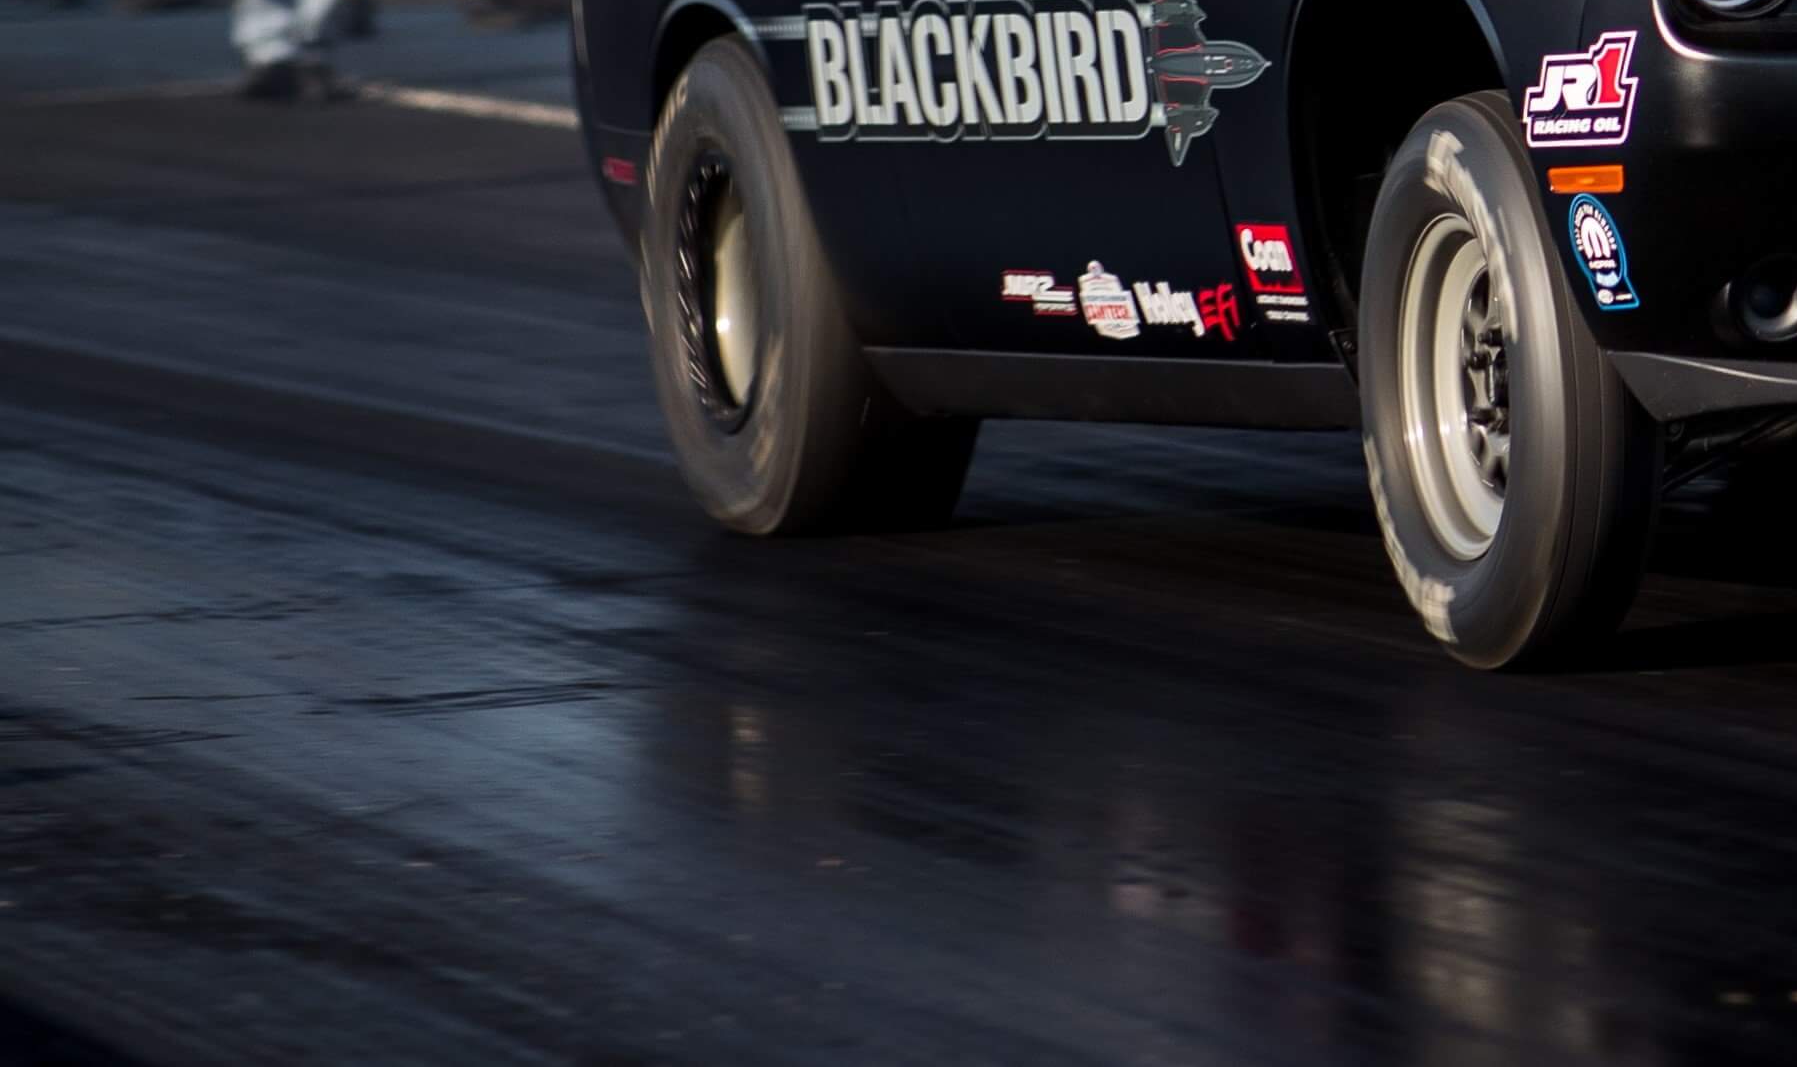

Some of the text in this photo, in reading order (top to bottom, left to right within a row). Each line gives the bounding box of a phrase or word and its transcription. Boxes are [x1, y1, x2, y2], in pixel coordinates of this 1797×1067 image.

[808, 8, 1150, 127] BLACKBIRD
[1529, 43, 1627, 112] JR1
[1533, 117, 1622, 135] RACING OIL
